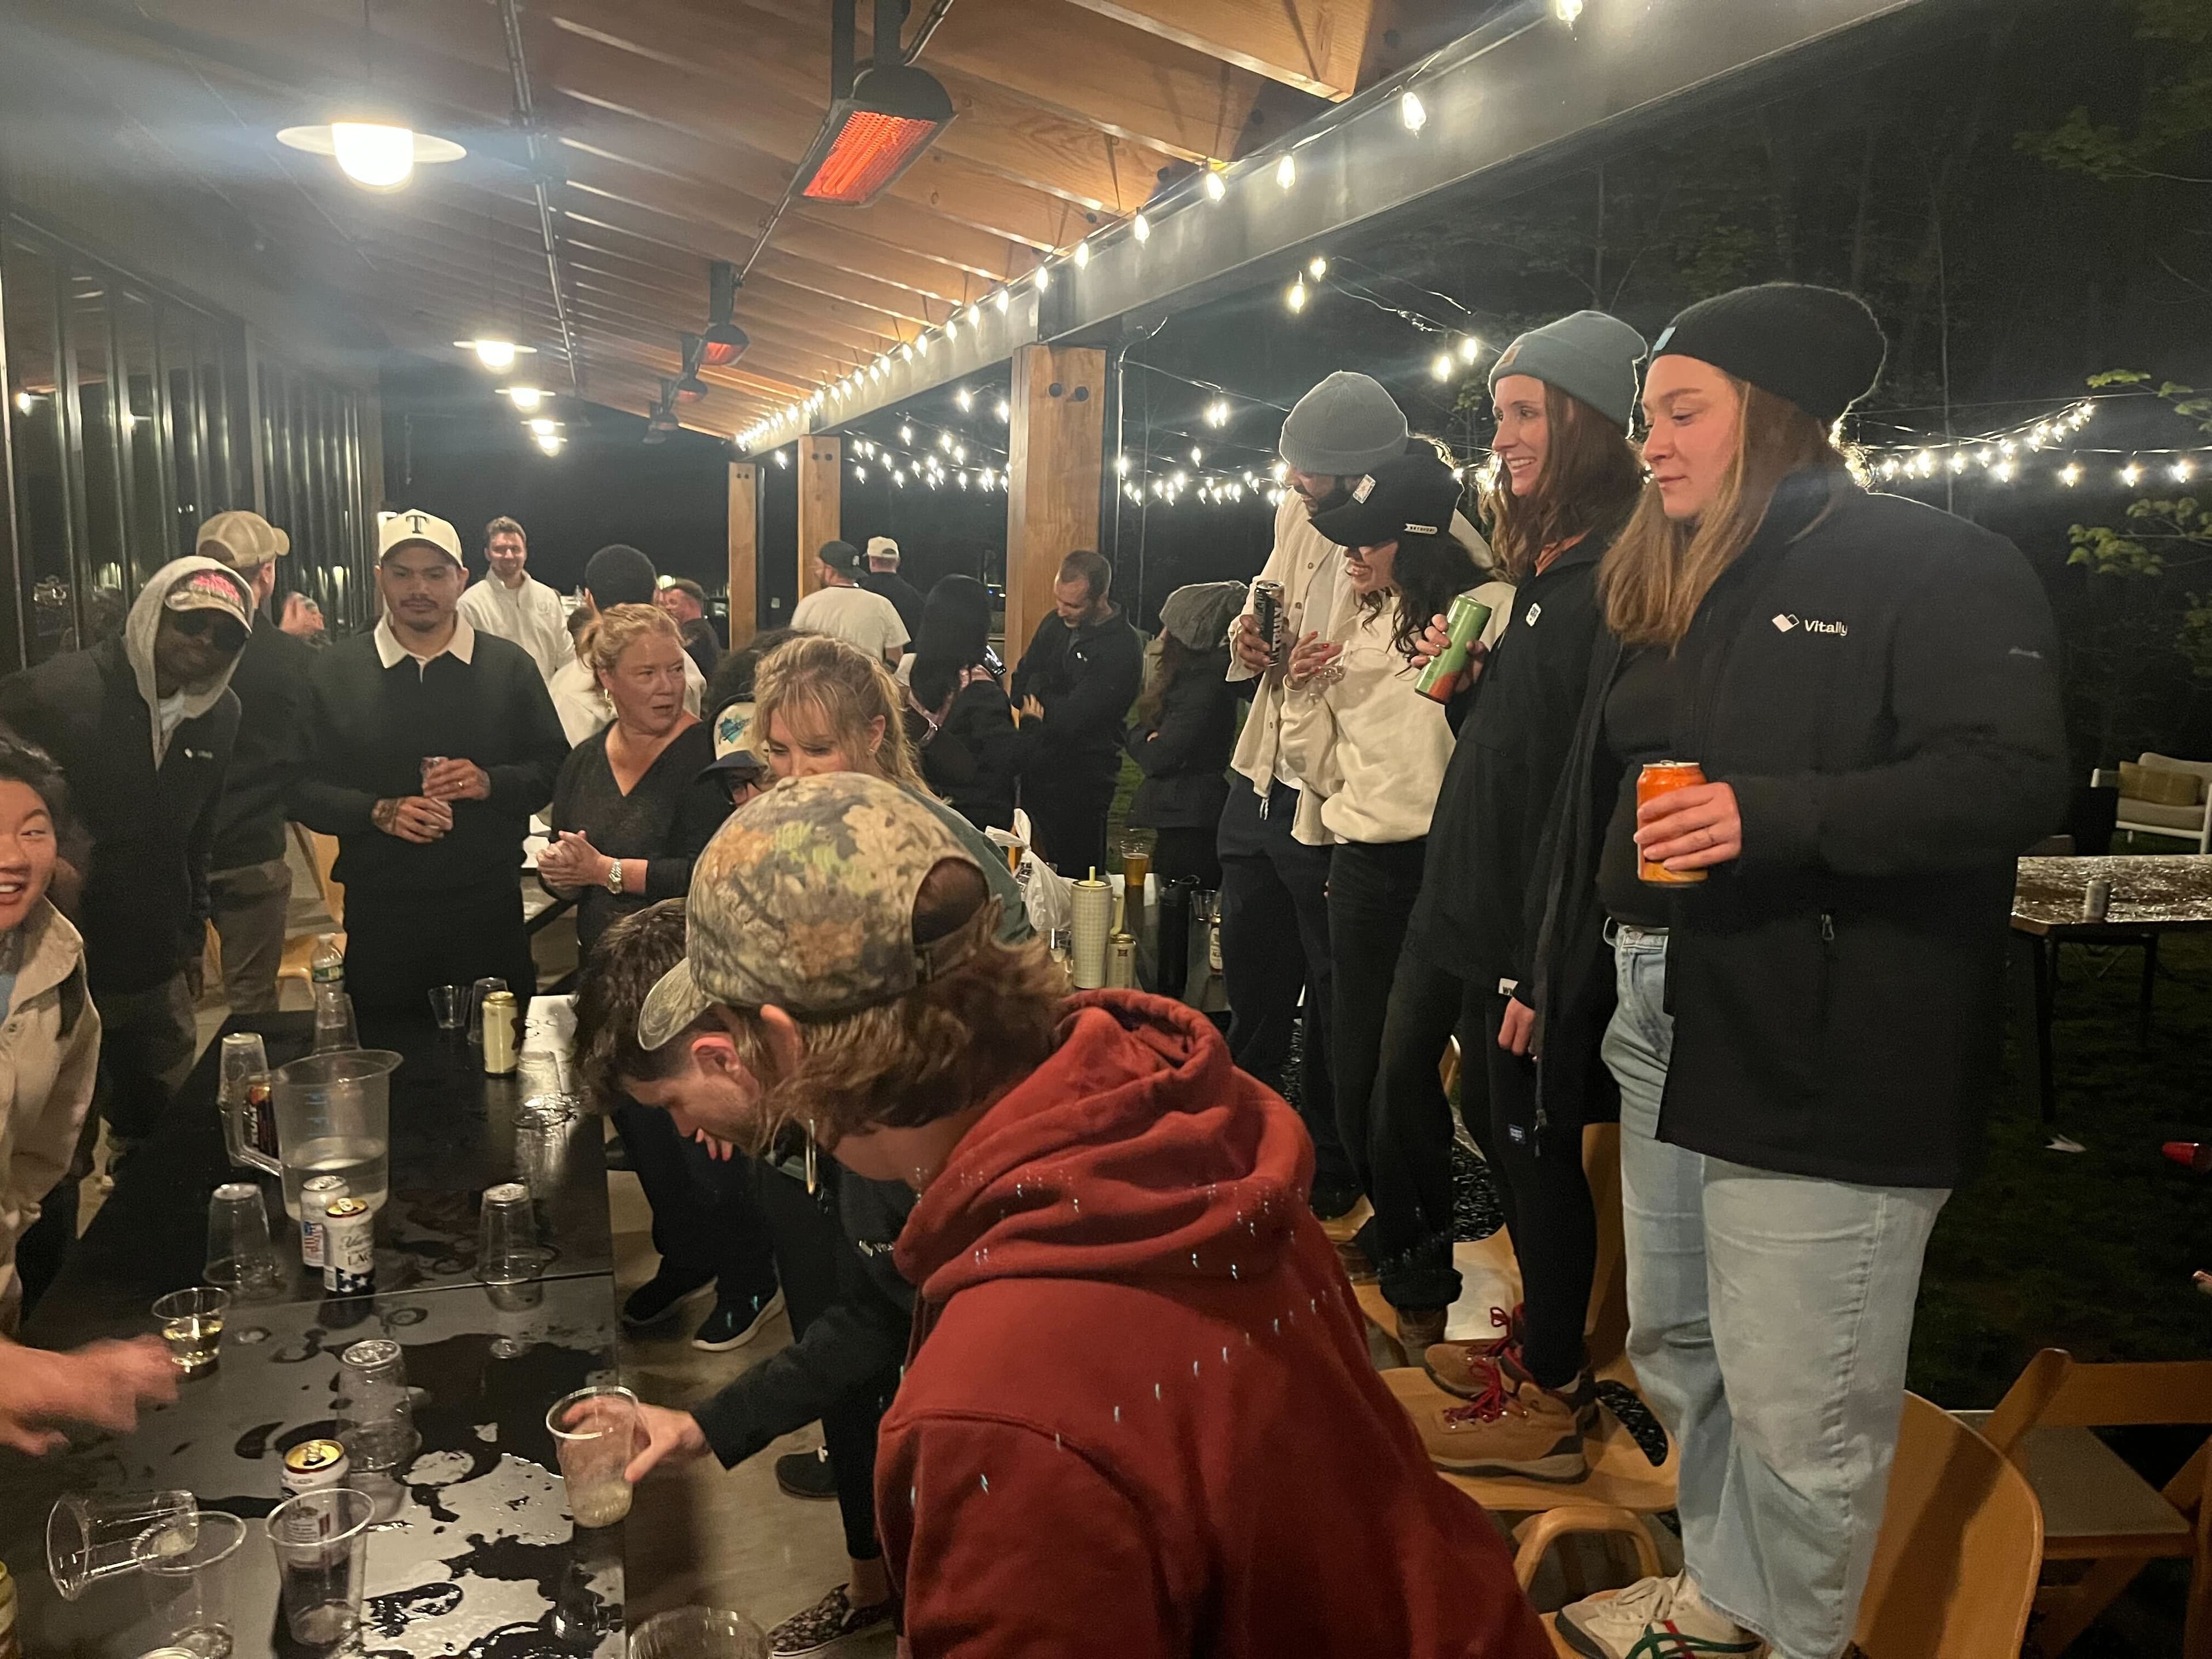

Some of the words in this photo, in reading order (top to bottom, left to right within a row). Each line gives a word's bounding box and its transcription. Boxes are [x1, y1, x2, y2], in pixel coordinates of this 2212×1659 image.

[406, 515, 429, 534] T
[1272, 607, 1283, 652] TRULY
[1804, 619, 1848, 637] Vitally
